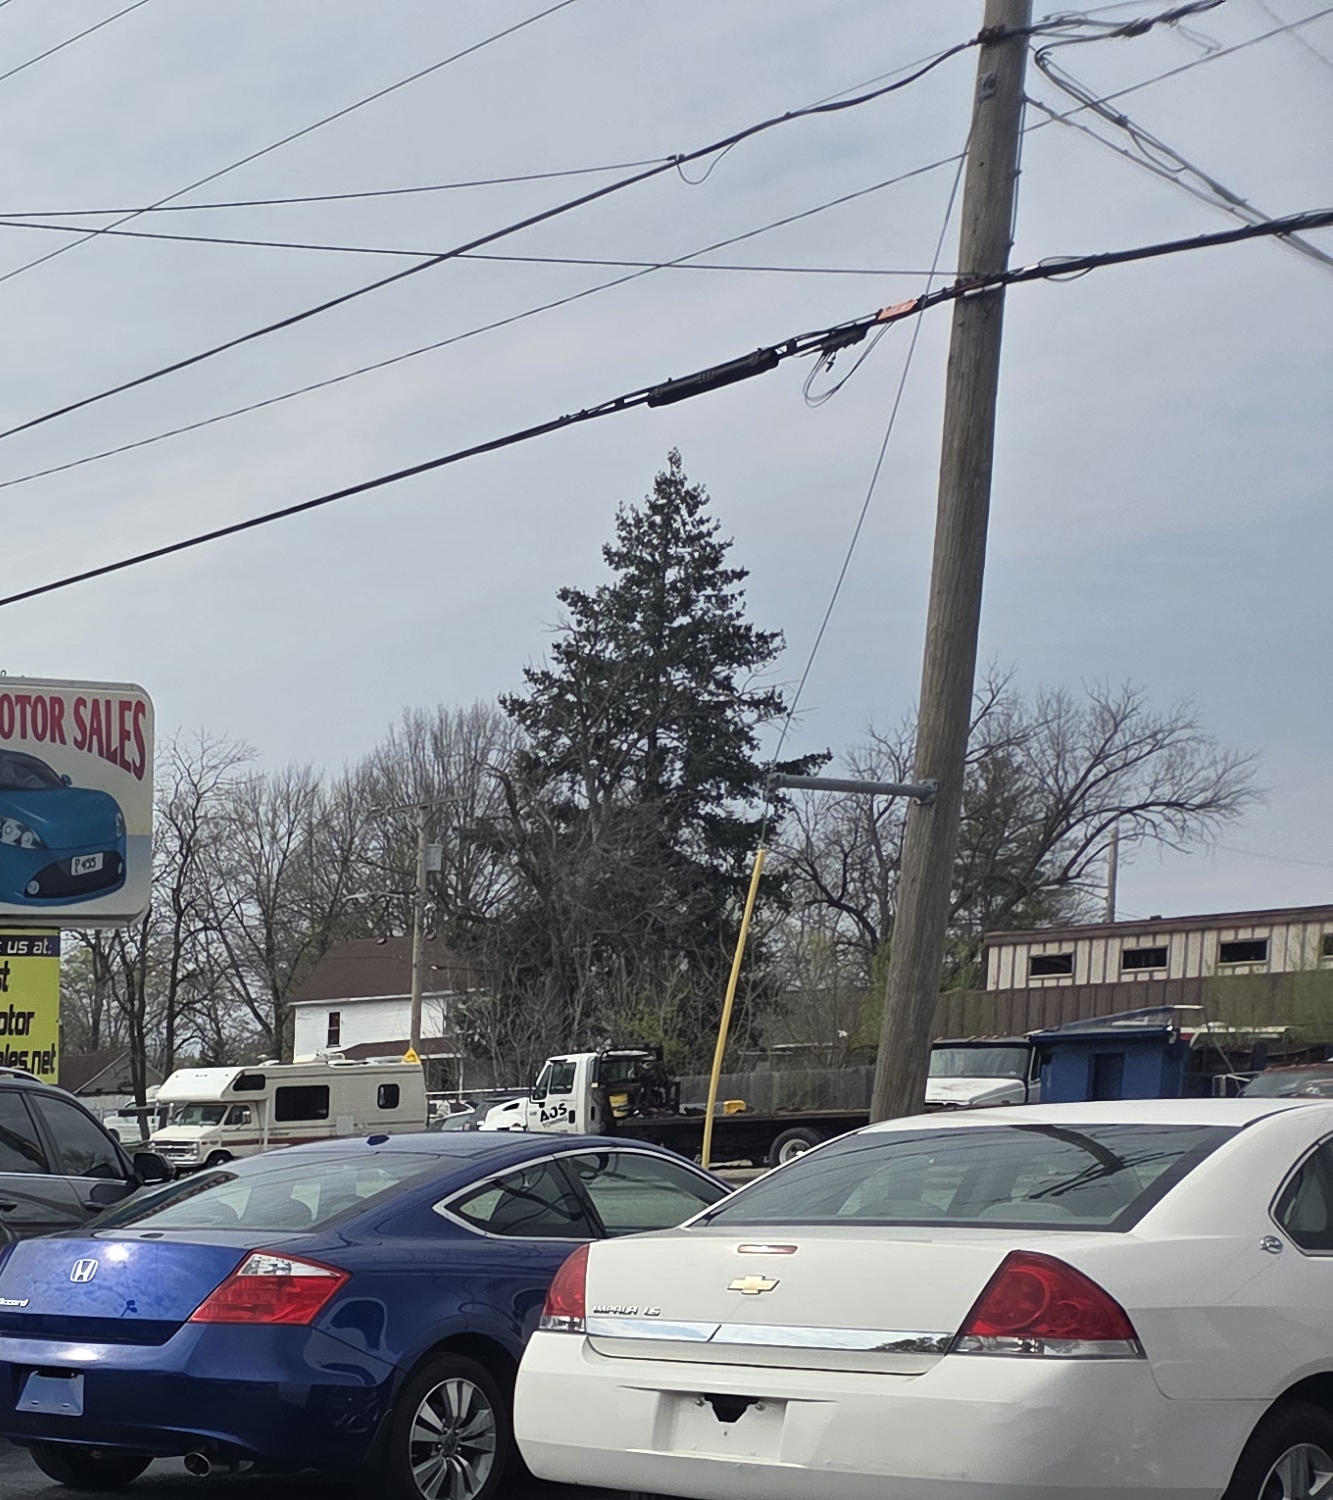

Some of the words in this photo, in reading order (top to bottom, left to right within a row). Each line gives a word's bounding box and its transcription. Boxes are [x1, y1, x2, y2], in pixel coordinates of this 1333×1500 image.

[72, 695, 147, 781] SALES
[7, 940, 28, 954] us
[32, 937, 51, 955] at:
